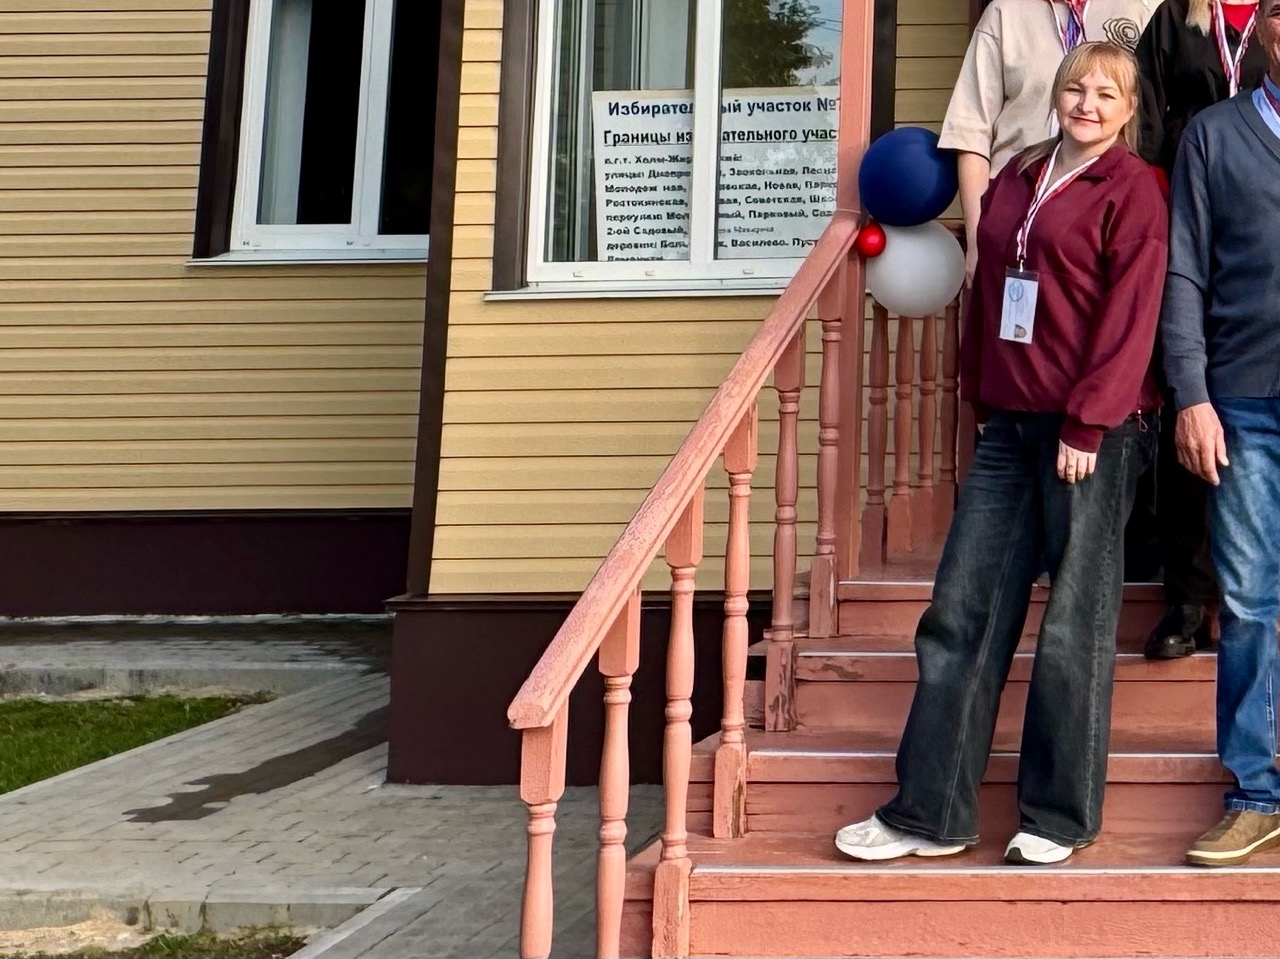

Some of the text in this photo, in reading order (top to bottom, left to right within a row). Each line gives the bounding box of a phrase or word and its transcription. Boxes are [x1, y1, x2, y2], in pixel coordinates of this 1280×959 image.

[608, 99, 742, 118] Избиратеый
[748, 101, 812, 117] участок
[603, 128, 838, 147] Границы изательного учас
